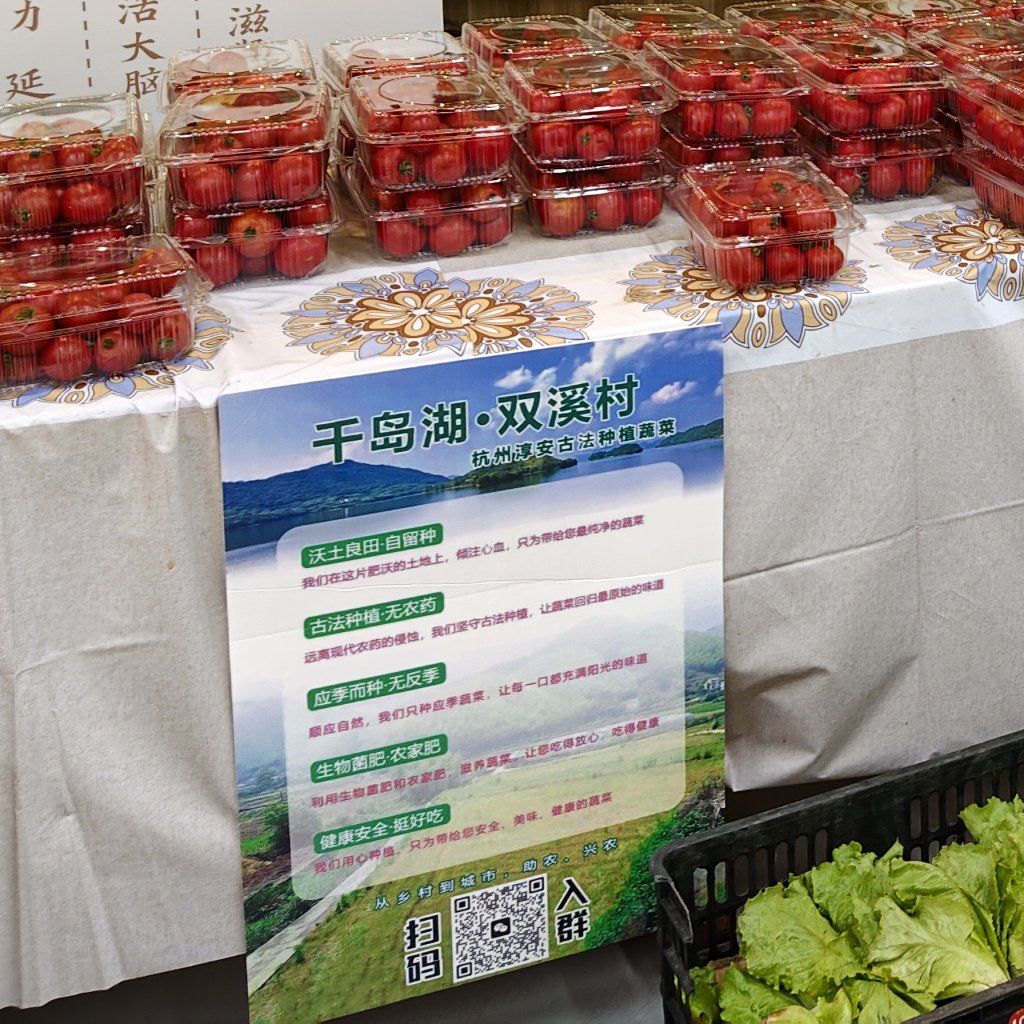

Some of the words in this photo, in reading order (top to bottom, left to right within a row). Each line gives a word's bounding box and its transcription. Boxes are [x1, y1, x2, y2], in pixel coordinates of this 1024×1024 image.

[228, 3, 270, 46] 滋
[312, 373, 641, 465] 千岛湖·双溪村
[471, 418, 677, 468] 杭州淳安古法种植蔬菜
[308, 528, 437, 565] 沃土良田·自留种
[310, 597, 437, 636] 古法种植·无农药
[314, 667, 440, 707] 应季而种·无反季
[316, 739, 442, 779] 生物菌肥·农家肥
[320, 808, 445, 851] 健康安全·挺好吃
[554, 877, 591, 945] 入群
[406, 913, 444, 985] 扫码
